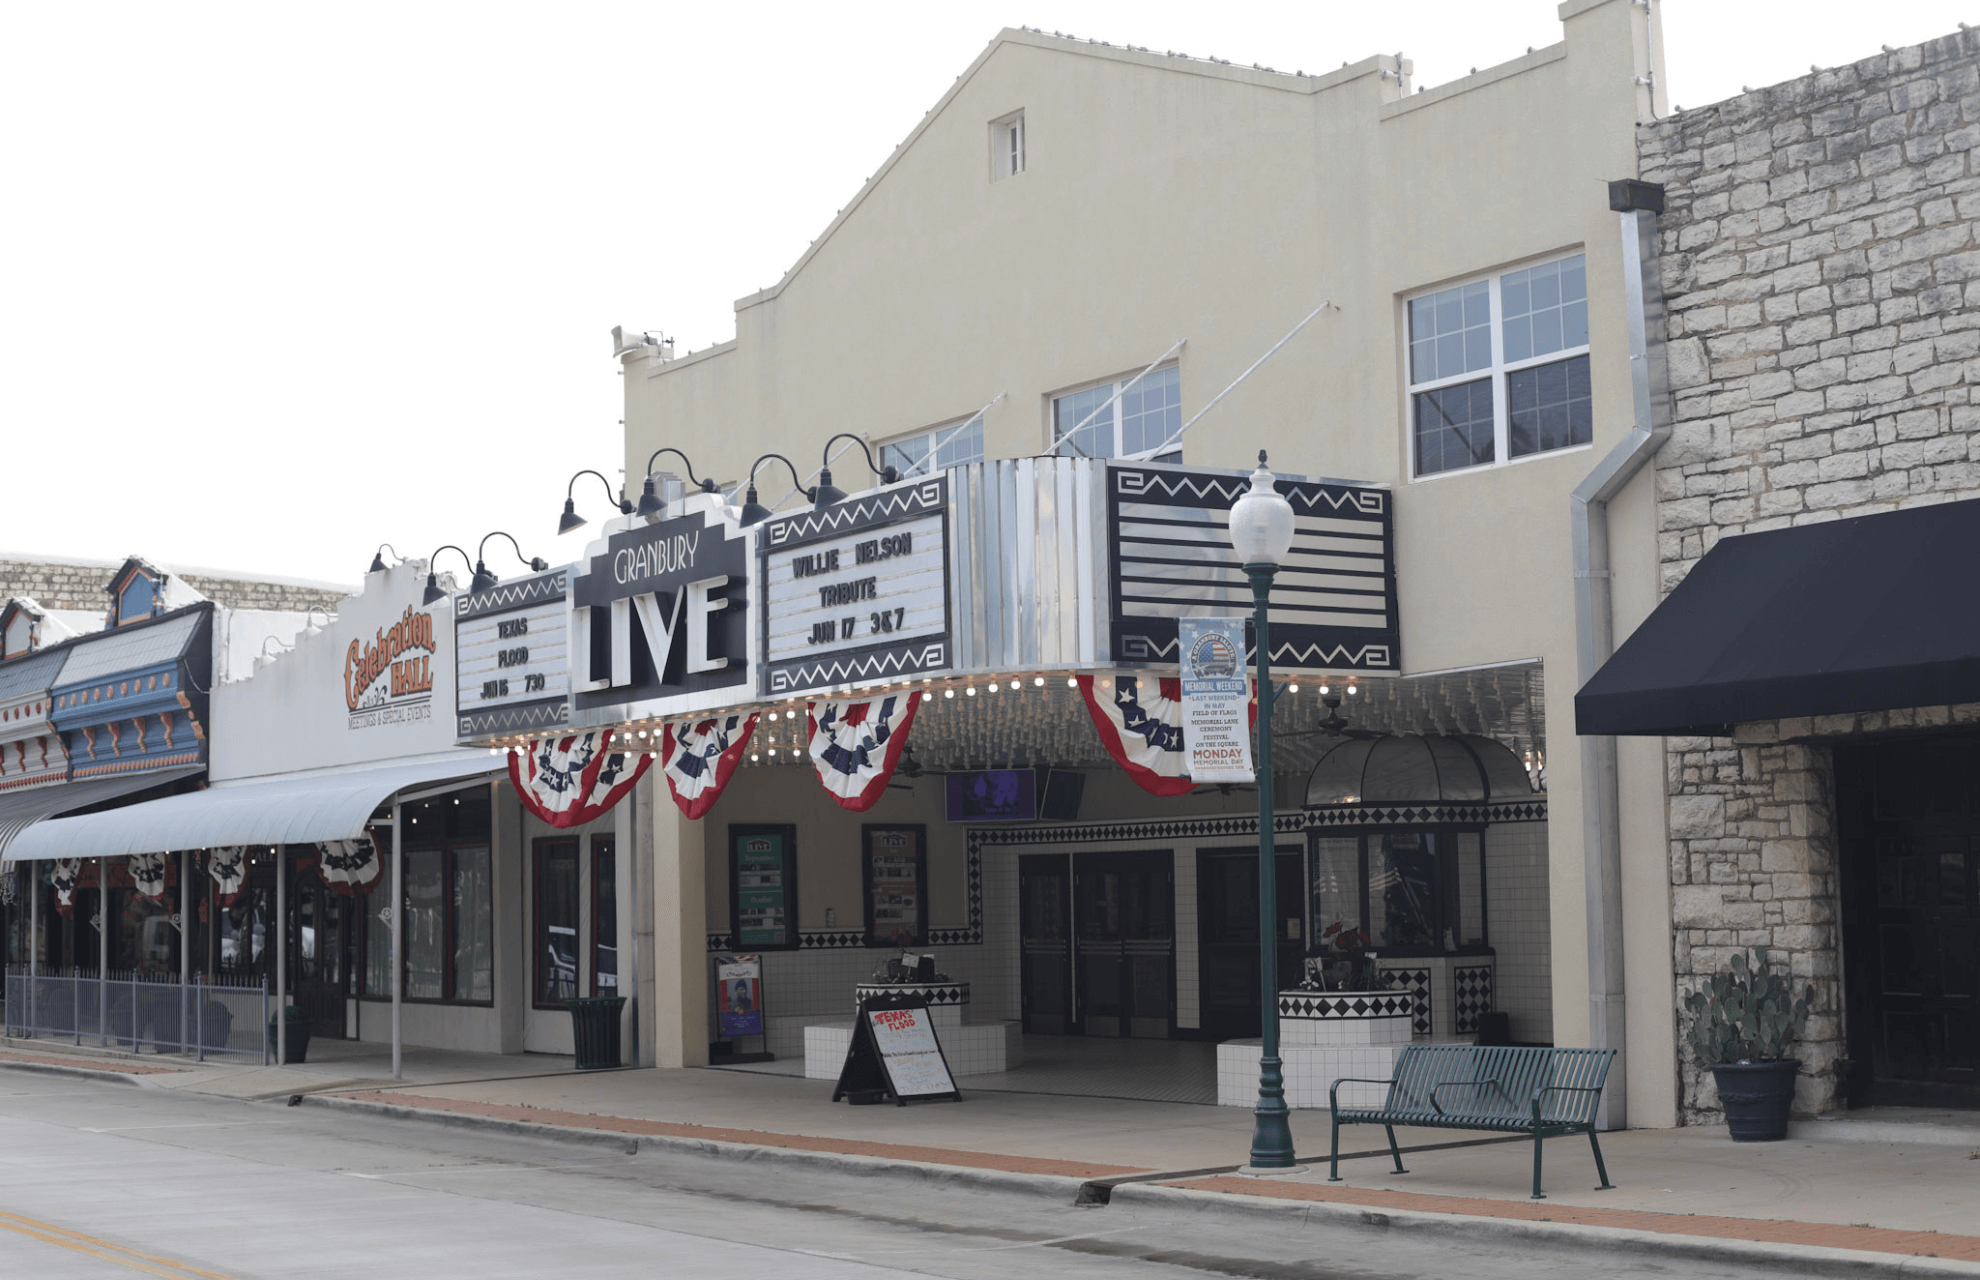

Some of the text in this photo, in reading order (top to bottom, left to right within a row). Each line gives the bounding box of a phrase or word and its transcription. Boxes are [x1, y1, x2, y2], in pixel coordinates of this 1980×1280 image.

[614, 530, 699, 584] GRANBURY
[792, 532, 912, 579] WILLIE NELSON
[819, 576, 877, 608] TRIBUTE
[497, 617, 528, 639] TEXAS
[572, 574, 729, 694] LIVE
[807, 620, 836, 645] JUN
[841, 616, 856, 640] 17
[344, 604, 436, 711] Celebration
[498, 646, 529, 669] FLOOD
[391, 655, 433, 698] HALL
[480, 673, 545, 700] JUN 16 730
[1185, 681, 1242, 691] MEMORIAL WEEKEND
[348, 713, 377, 731] MEETINGS
[382, 708, 406, 725] SPECIAL
[407, 704, 431, 721] EVENTS
[1193, 748, 1243, 759] MONDAY
[874, 1010, 913, 1025] TEXAS
[888, 1018, 916, 1032] FLOOD
